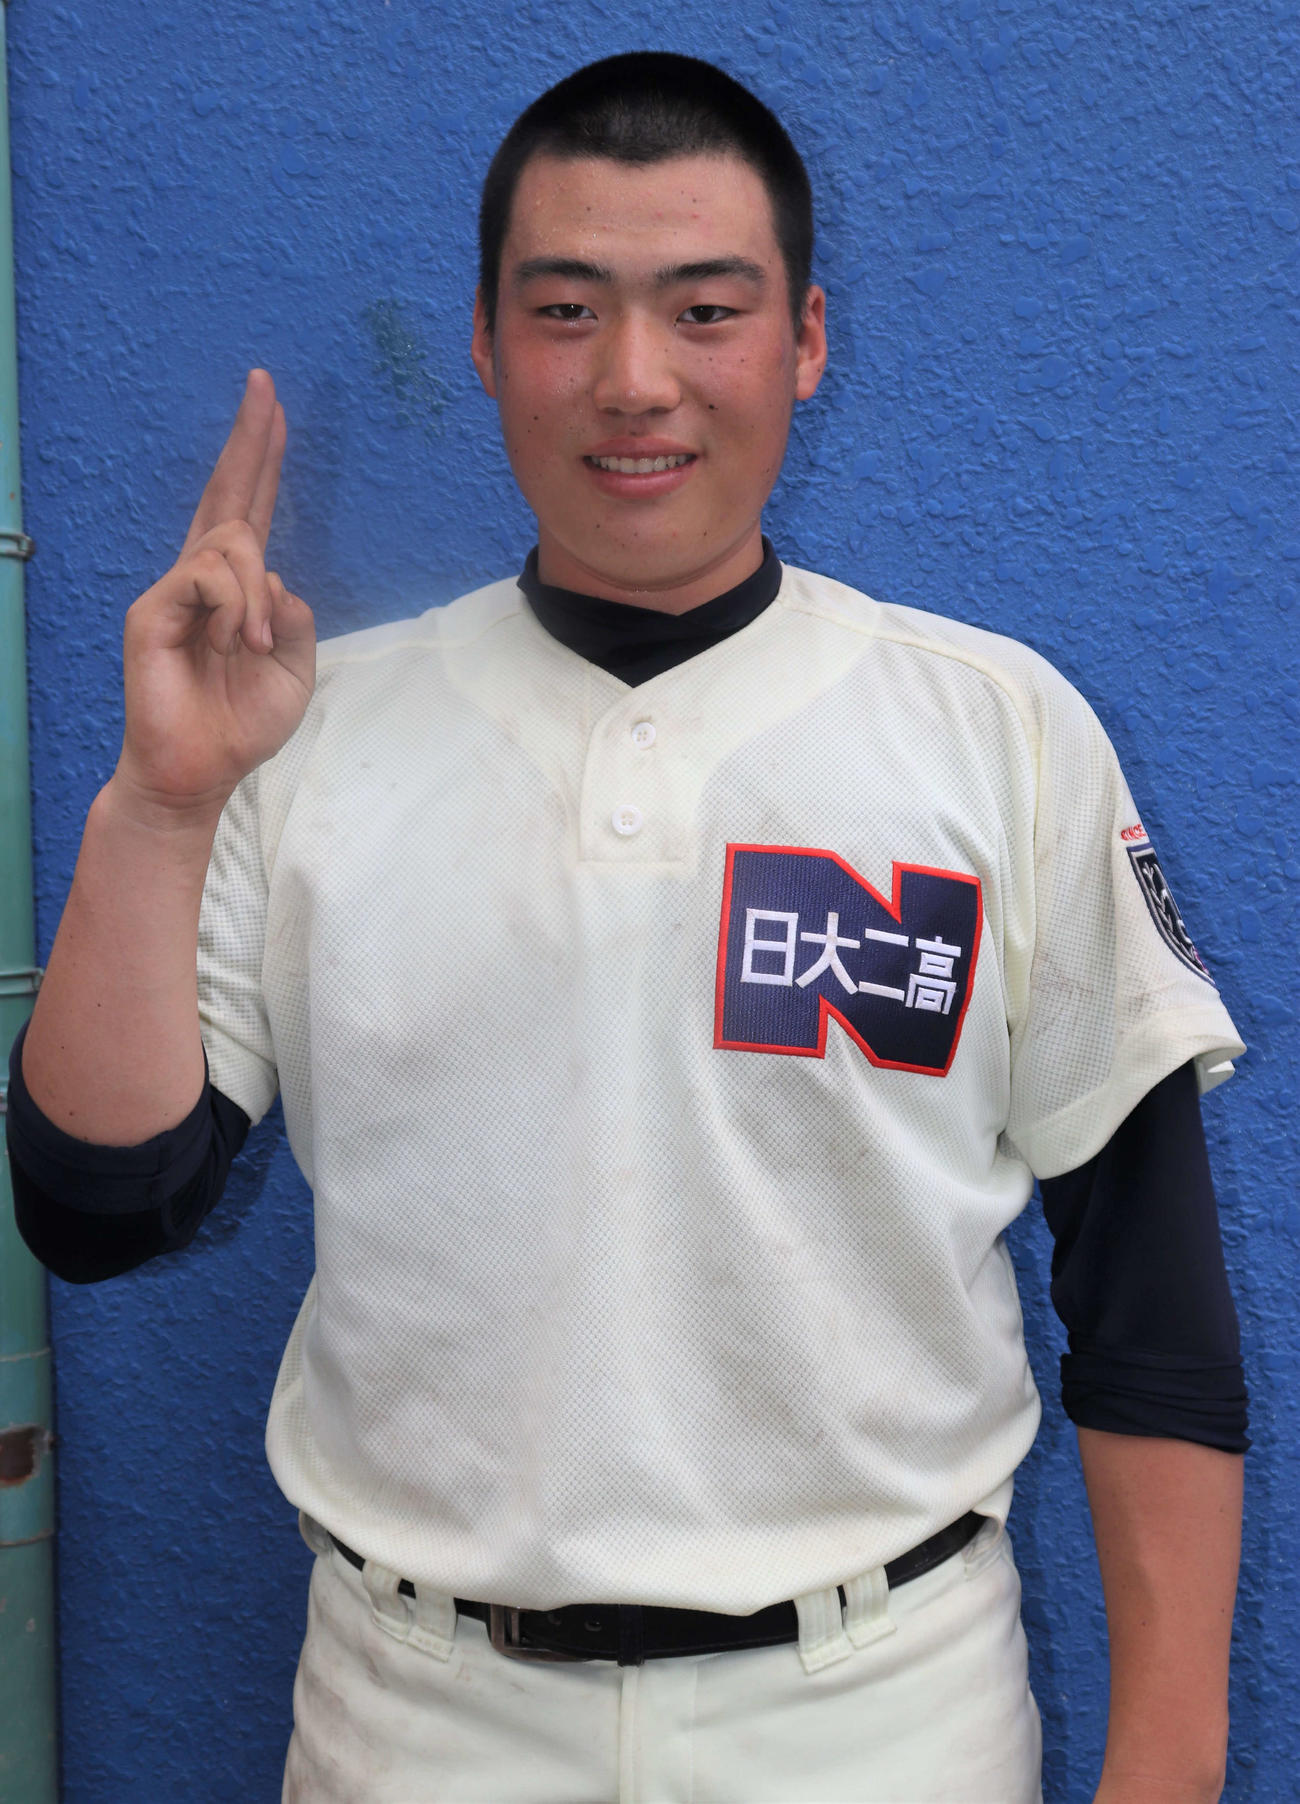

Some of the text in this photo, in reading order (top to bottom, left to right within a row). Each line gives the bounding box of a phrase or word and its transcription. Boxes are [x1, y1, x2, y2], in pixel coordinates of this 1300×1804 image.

[713, 843, 983, 1077] N
[740, 908, 961, 1015] 日大二高
